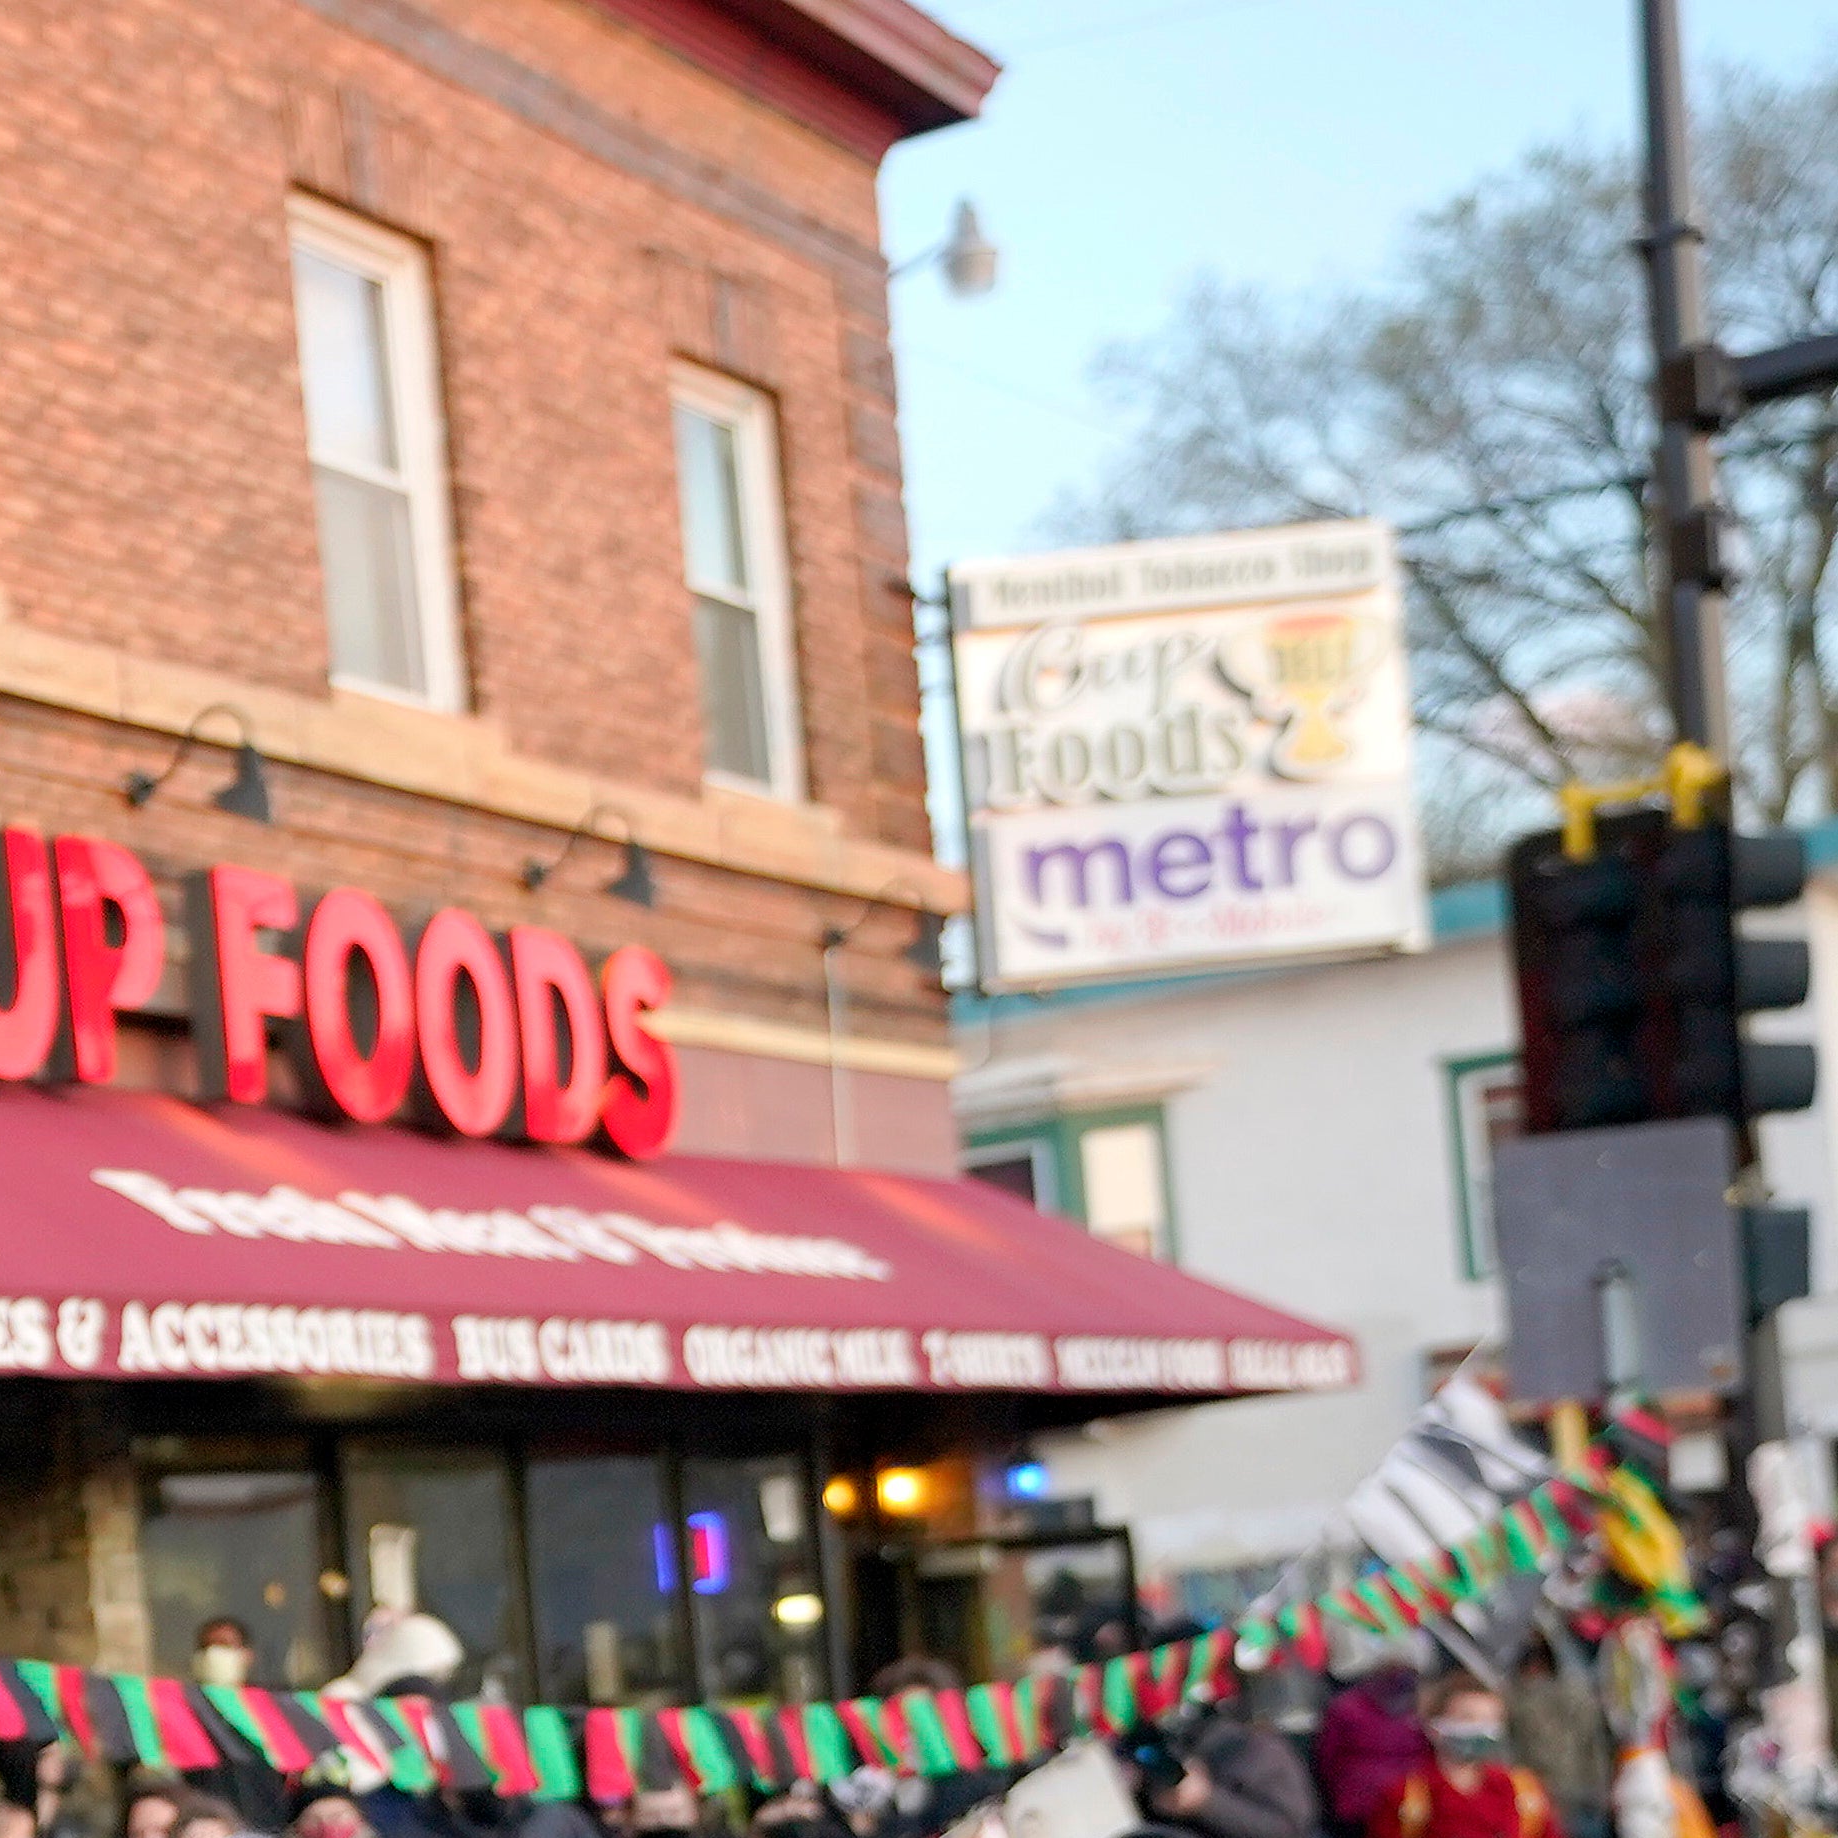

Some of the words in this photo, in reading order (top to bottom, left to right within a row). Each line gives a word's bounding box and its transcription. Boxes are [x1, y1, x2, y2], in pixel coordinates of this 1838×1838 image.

[996, 619, 1217, 721] Cup
[1023, 805, 1398, 907] metro
[211, 862, 682, 1160] FOODS
[56, 1296, 107, 1370] &
[117, 1300, 434, 1378] ACCESSORIES
[538, 1315, 672, 1384] CARDS
